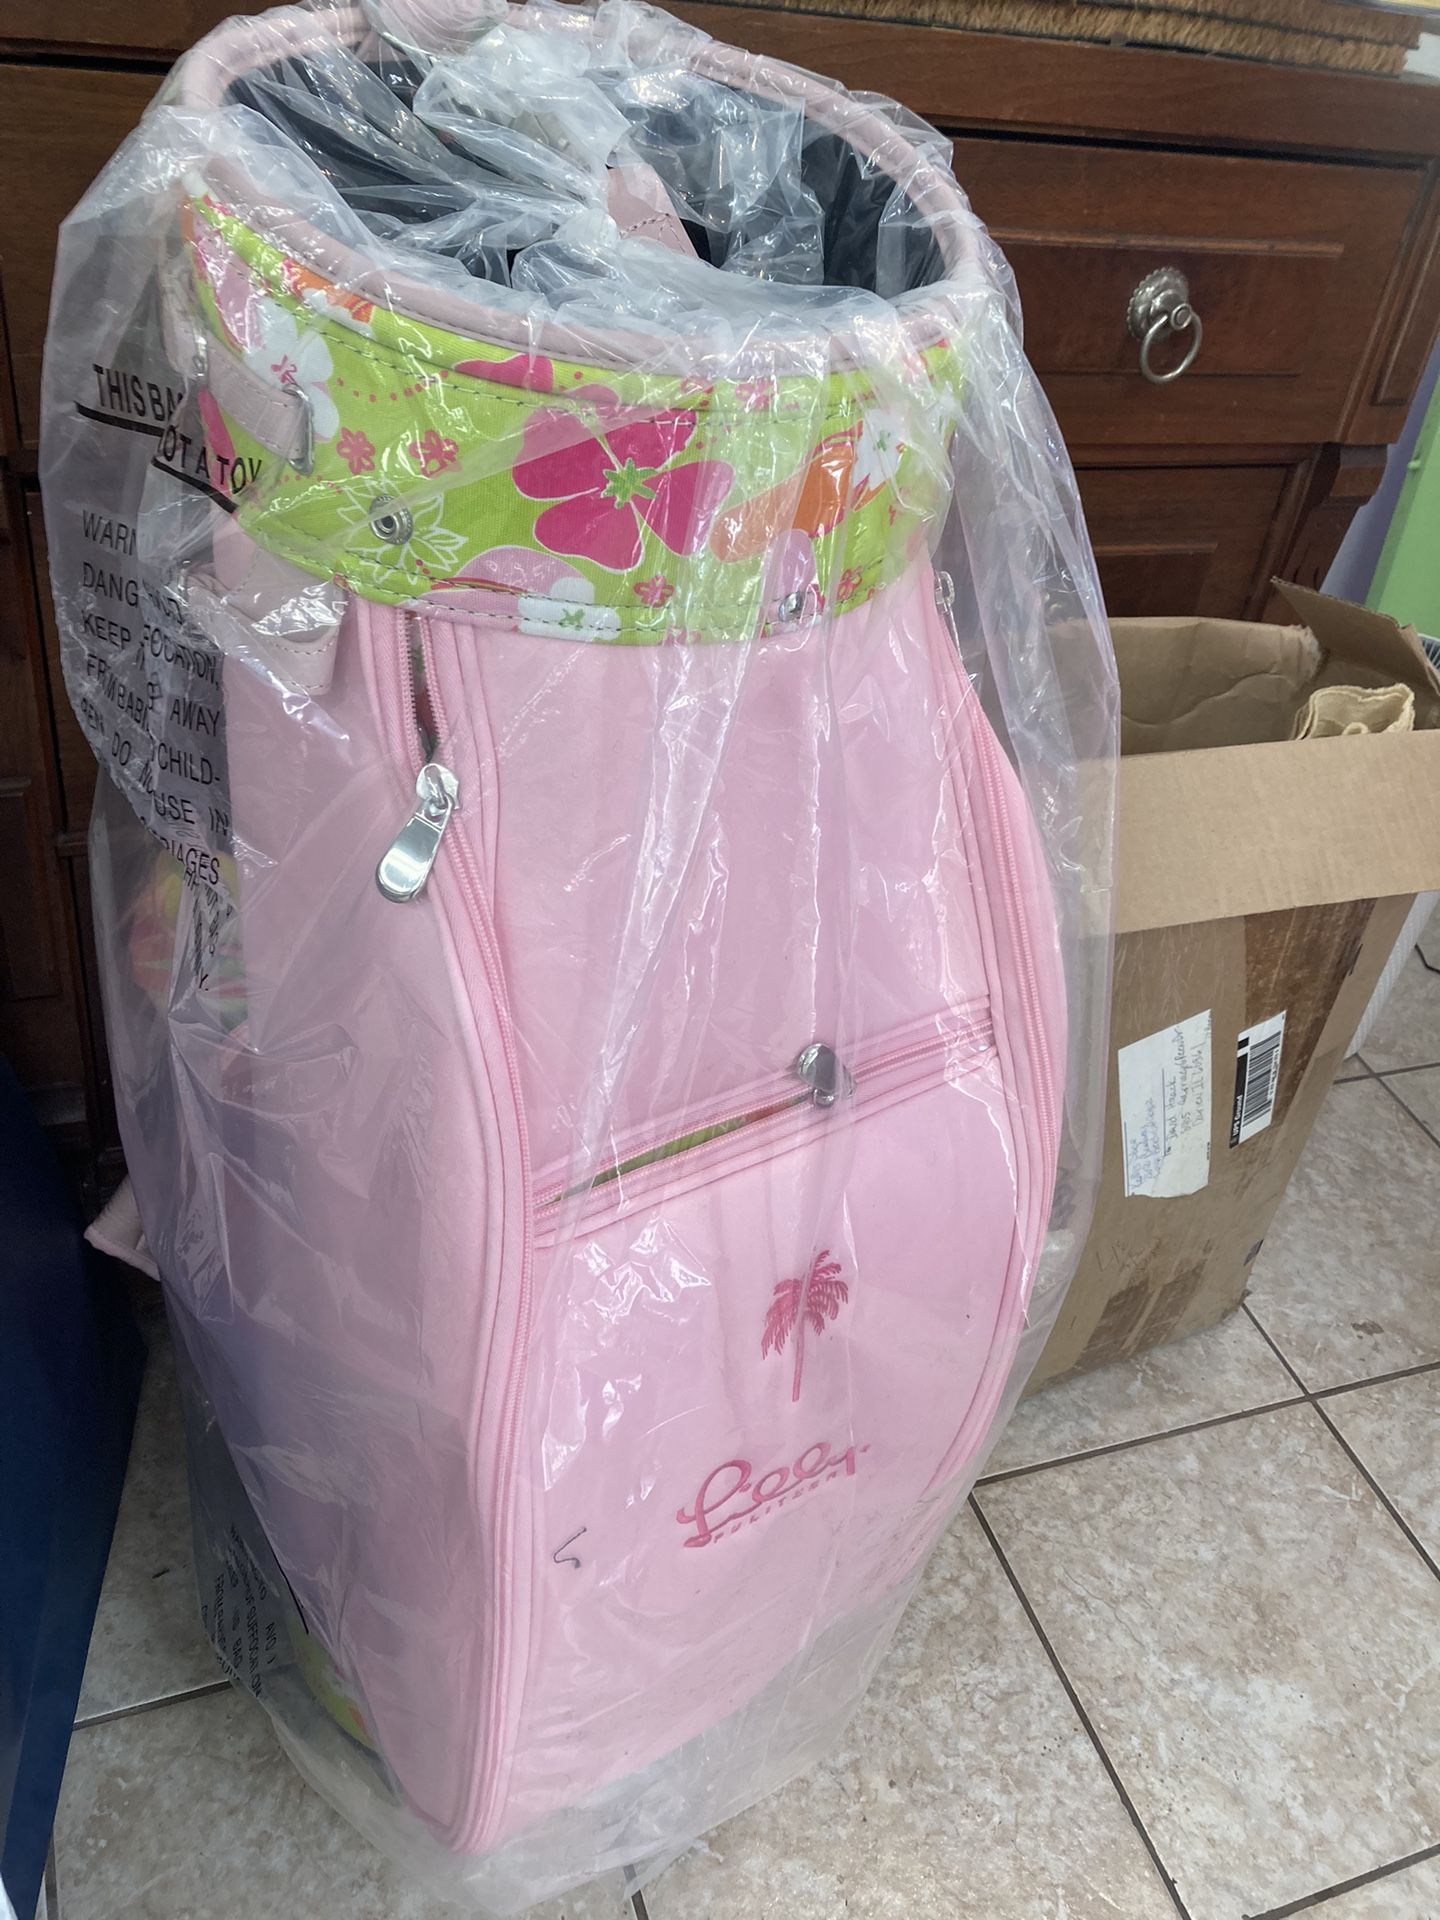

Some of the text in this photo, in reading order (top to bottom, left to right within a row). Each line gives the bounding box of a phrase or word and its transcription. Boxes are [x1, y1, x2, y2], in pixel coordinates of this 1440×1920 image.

[93, 363, 147, 418] THIS
[195, 446, 211, 480] A
[80, 610, 131, 650] KEEP
[169, 697, 221, 738] AWAY
[154, 793, 196, 825] USE
